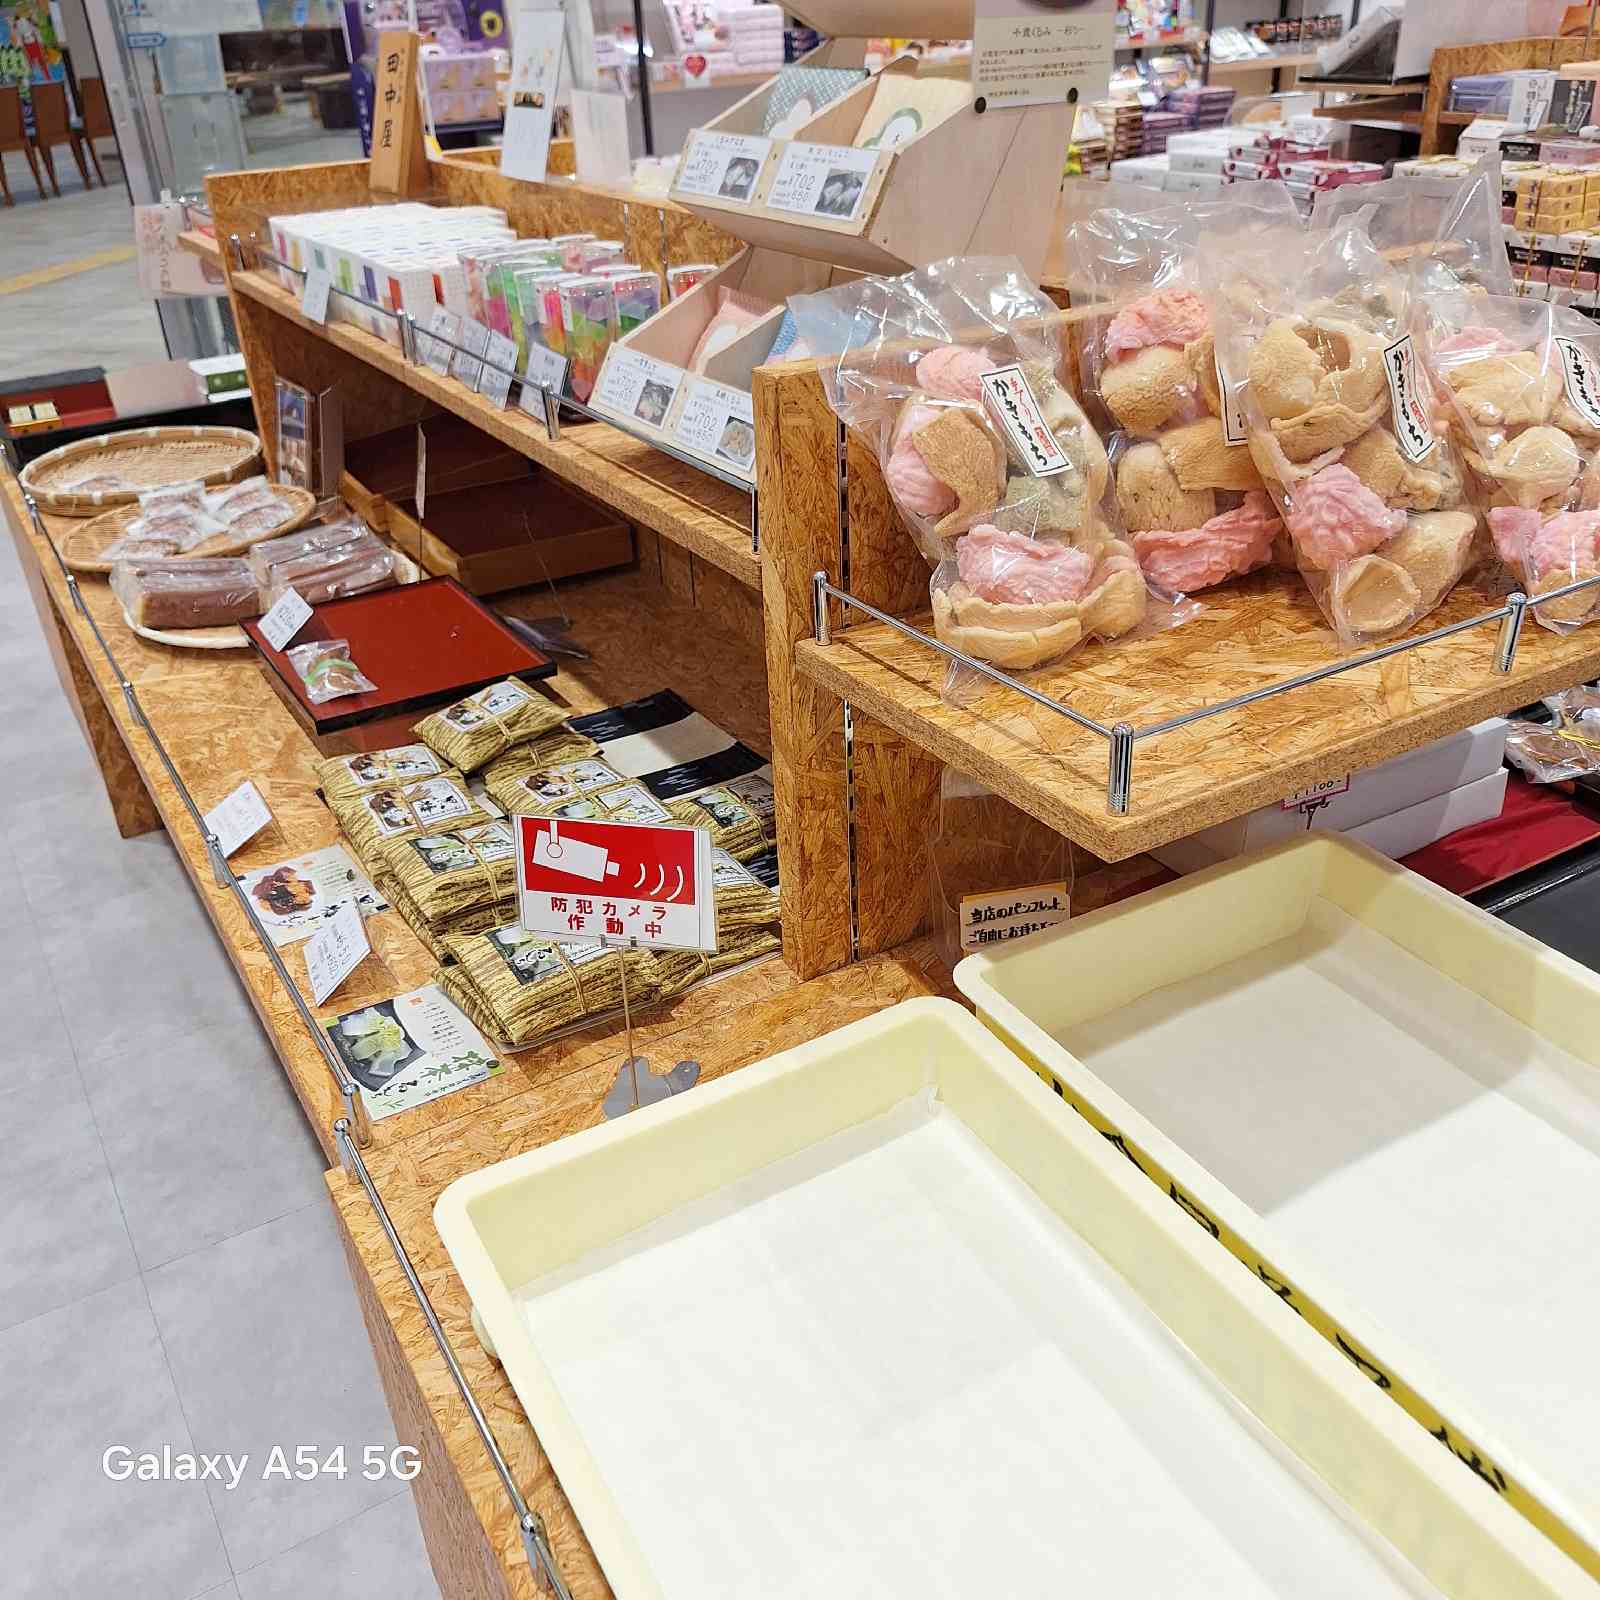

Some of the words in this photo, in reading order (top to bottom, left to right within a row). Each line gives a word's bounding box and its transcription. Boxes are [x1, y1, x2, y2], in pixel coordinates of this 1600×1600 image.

[551, 896, 667, 920] 防犯カメラ
[567, 914, 662, 938] 作動中
